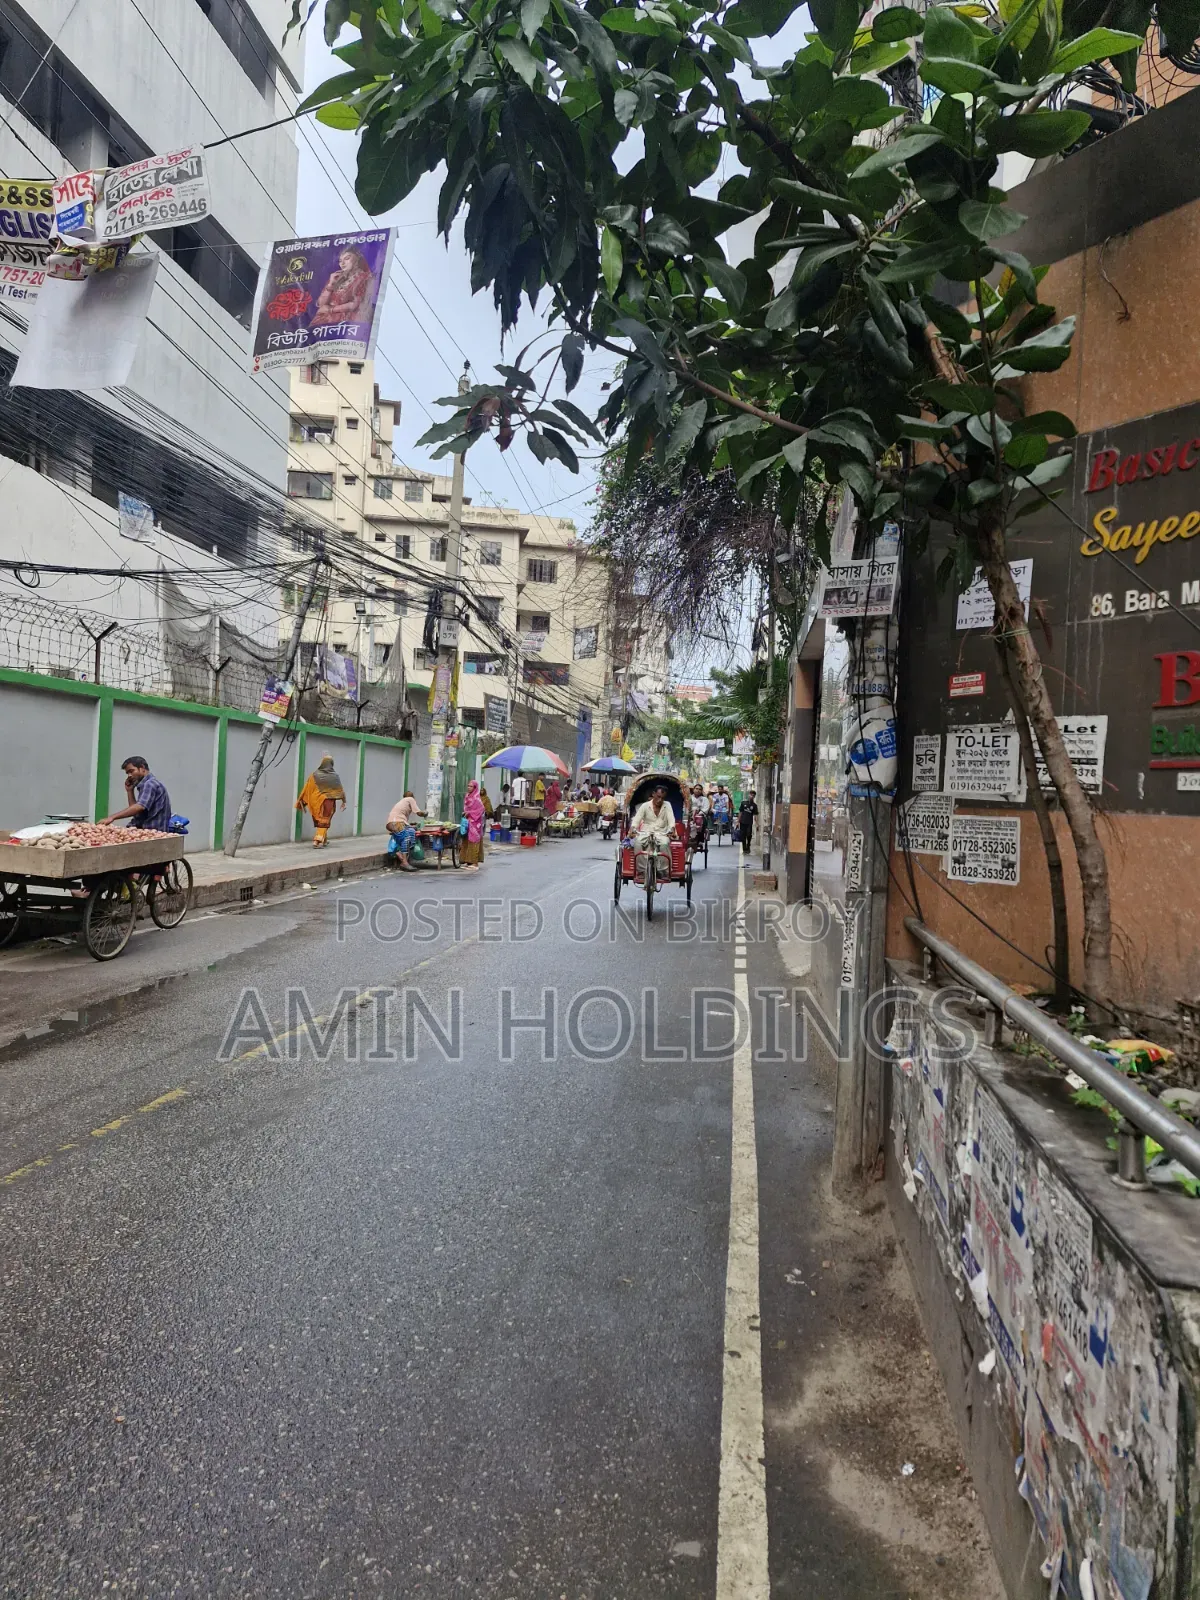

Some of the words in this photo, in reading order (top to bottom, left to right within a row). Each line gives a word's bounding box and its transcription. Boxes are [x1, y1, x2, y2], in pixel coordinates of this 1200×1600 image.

[0, 210, 55, 240] GLIS
[104, 198, 207, 235] 01718-269446
[0, 265, 45, 286] 757-20
[8, 285, 28, 299] Test
[267, 329, 309, 349] বিউটি
[312, 321, 360, 338] পার্লার
[1085, 437, 1200, 493] Basic
[1091, 593, 1116, 619] 86,
[1125, 589, 1170, 613] Bara
[1059, 724, 1098, 734] -Let
[955, 735, 1011, 748] TO-LET
[915, 749, 937, 767] ছবি
[950, 782, 1008, 792] 01916329447
[952, 839, 1017, 855] 01728-552305
[952, 866, 1017, 881] 01828-353920
